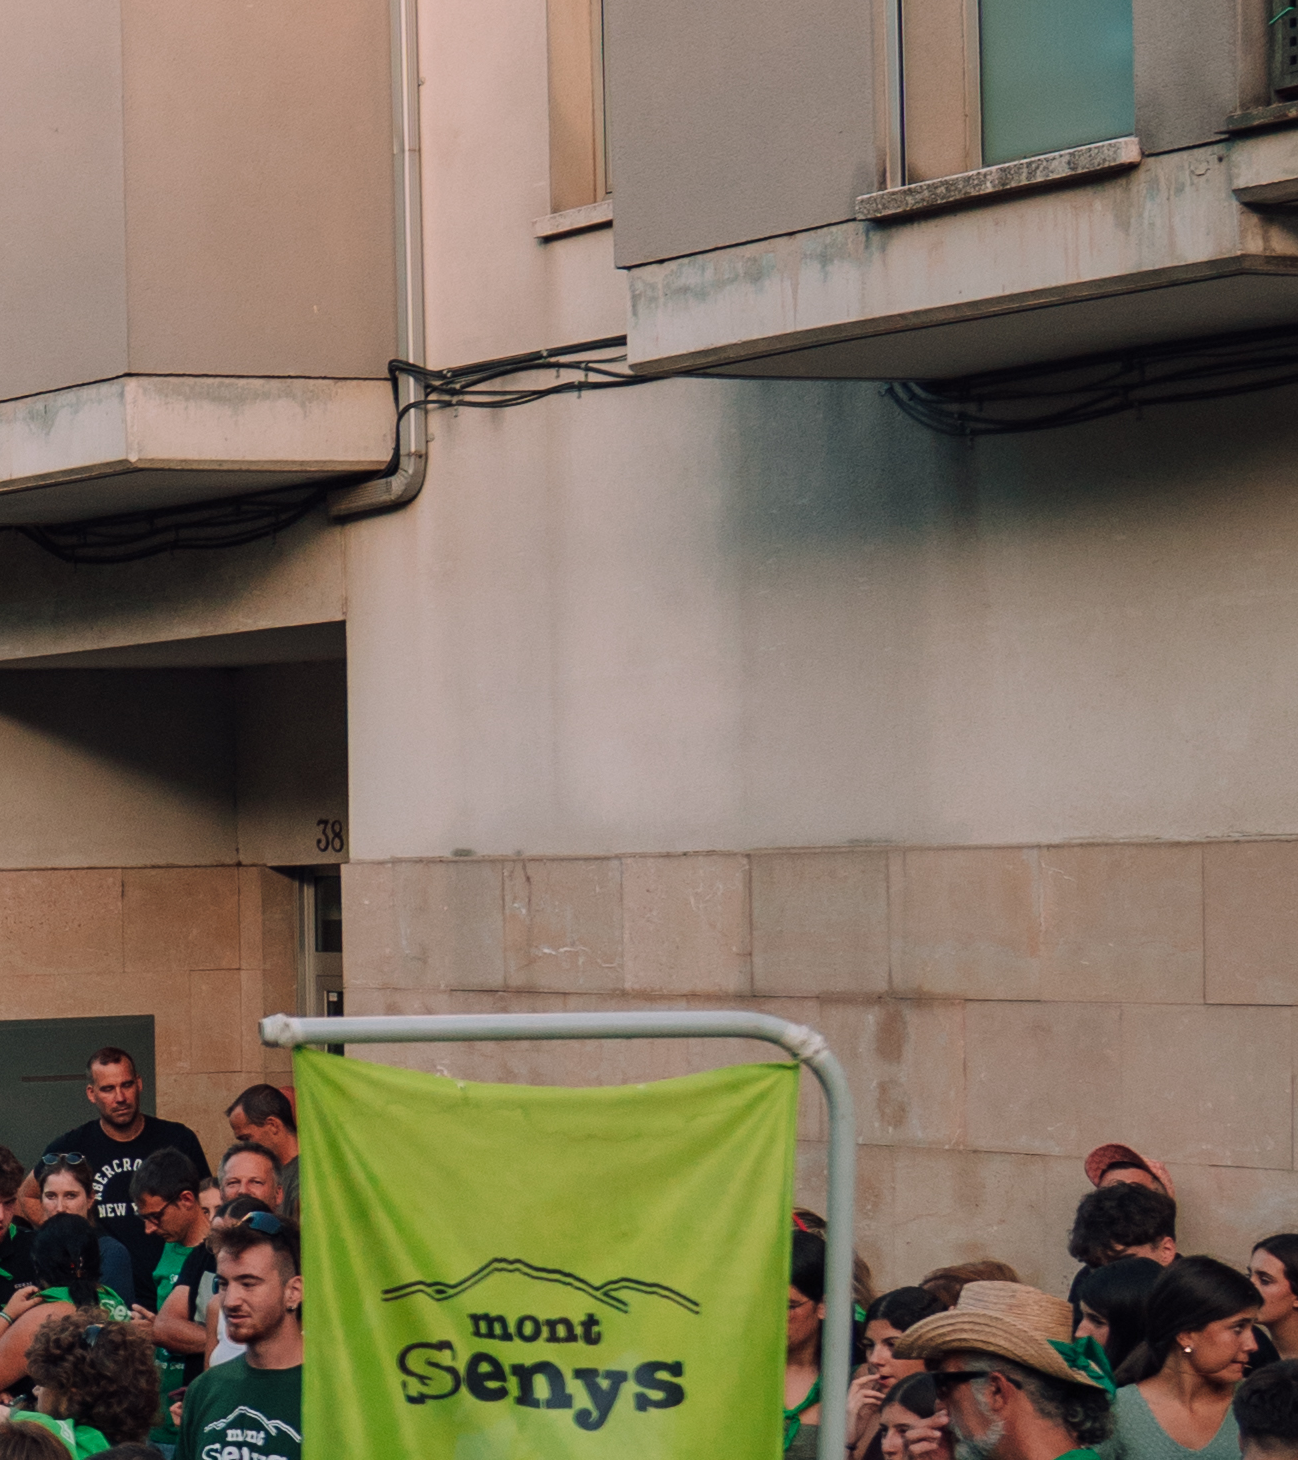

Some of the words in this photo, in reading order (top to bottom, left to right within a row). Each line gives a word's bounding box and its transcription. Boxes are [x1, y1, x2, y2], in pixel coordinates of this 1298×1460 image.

[98, 1202, 127, 1219] NEW
[467, 1312, 602, 1346] mont
[396, 1339, 686, 1431] Senys
[225, 1428, 266, 1447] mnt
